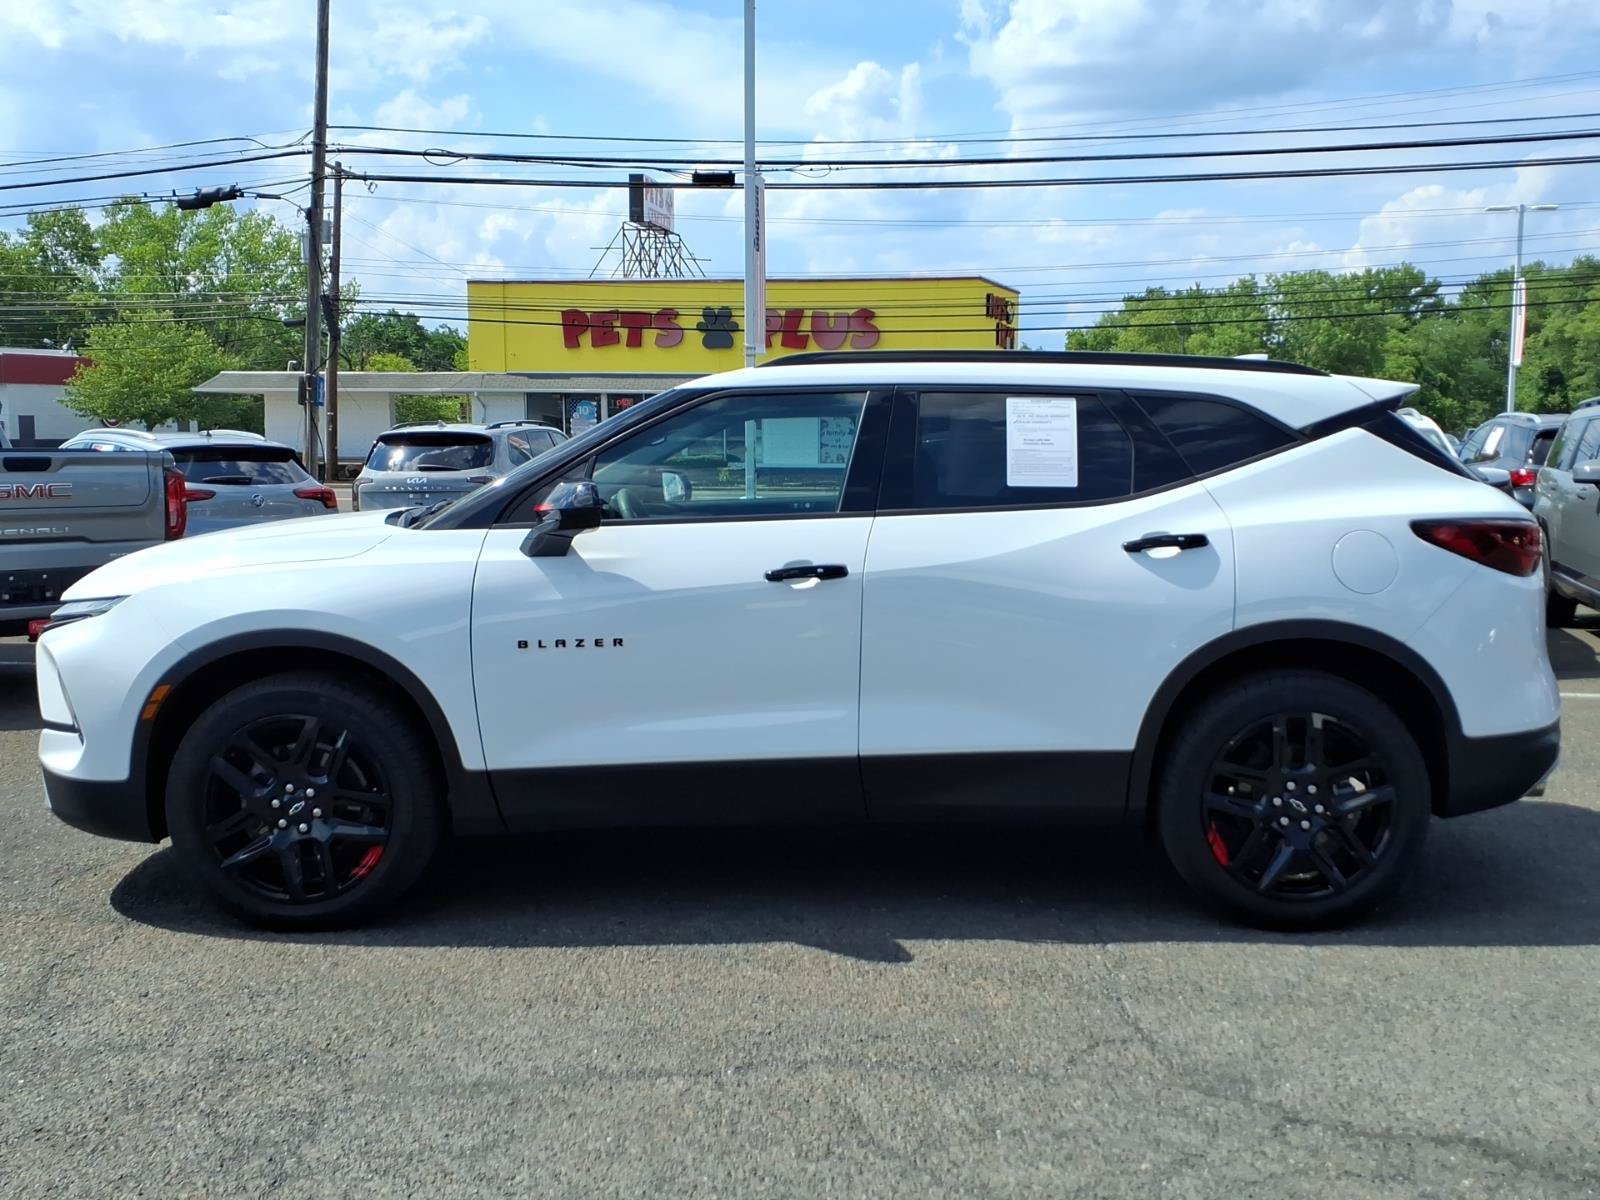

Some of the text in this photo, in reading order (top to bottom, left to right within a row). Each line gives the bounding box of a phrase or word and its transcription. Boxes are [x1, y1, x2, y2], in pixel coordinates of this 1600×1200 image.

[561, 308, 683, 349] PETS
[0, 526, 69, 535] ENALI
[517, 637, 624, 649] BLAZER
